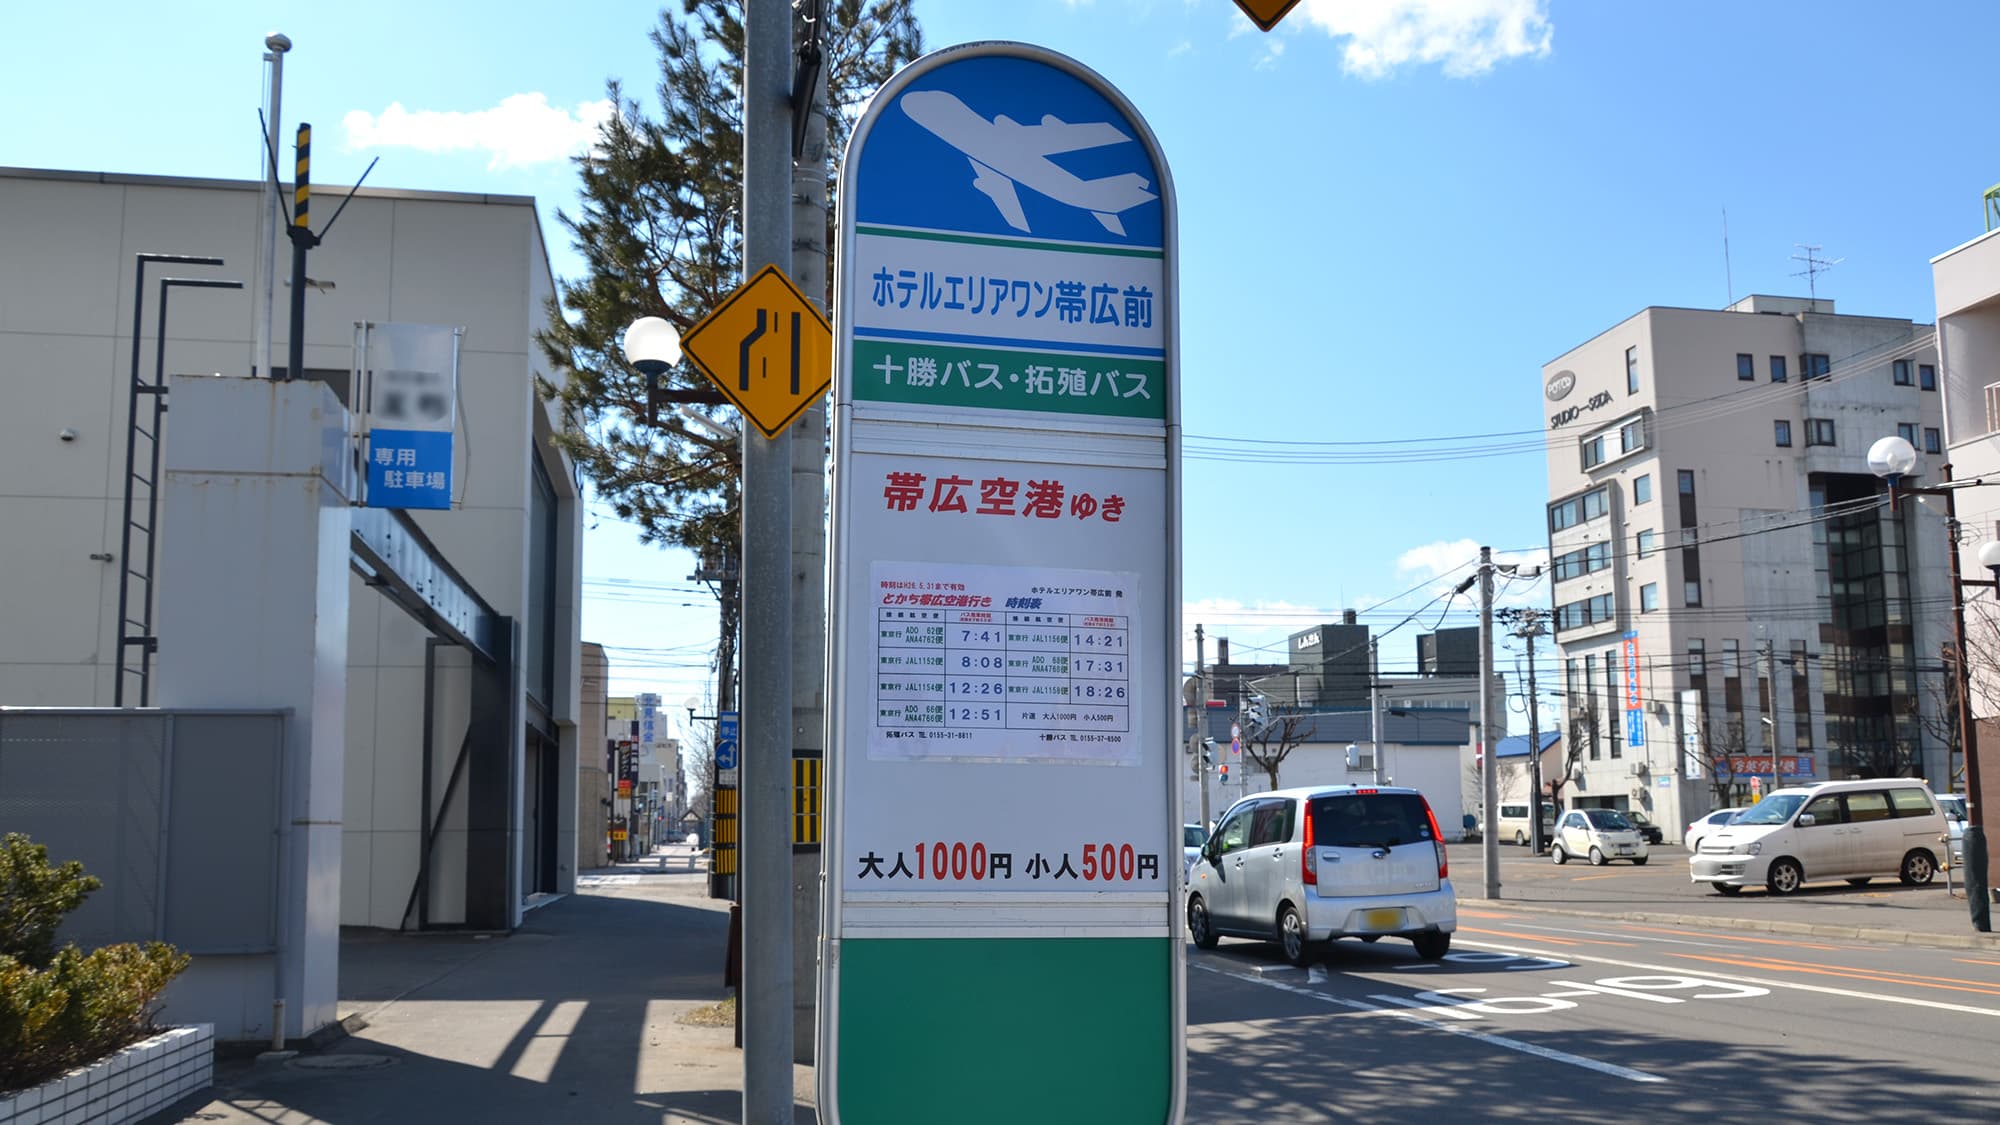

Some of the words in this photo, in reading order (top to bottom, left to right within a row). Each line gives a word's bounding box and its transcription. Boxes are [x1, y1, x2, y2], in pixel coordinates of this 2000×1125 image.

[873, 266, 1153, 328] ホテルエリアワン帯広前
[872, 354, 1151, 400] 十勝バス・拓殖バス
[375, 447, 417, 467] 専用
[384, 470, 446, 490] 駐車場
[883, 471, 1126, 522] 帯広空港ゆき
[1031, 587, 1112, 598] ホテルエリアワン帯広前
[882, 593, 992, 608] とかち帯広空港行き
[1005, 596, 1043, 609] 時刻表
[881, 630, 902, 639] 東京行
[905, 626, 918, 634] ADO
[961, 630, 1000, 643] 7:41
[1074, 634, 1123, 647] 14:21
[880, 656, 902, 665] 東京行
[905, 656, 943, 665] JAL1152便
[961, 656, 1003, 668] 8:08
[1032, 656, 1045, 664] ADO
[1075, 660, 1123, 673] 17:31
[880, 683, 902, 691] 東京行
[905, 683, 943, 692] JAL1154便
[950, 682, 1003, 694] 12:26
[1075, 686, 1125, 698] 18:26
[880, 709, 902, 717] 東京行
[905, 705, 918, 713] ADO
[950, 709, 1001, 721] 12:51
[858, 842, 1012, 880] 大人1000円
[1025, 844, 1159, 880] 小人500円
